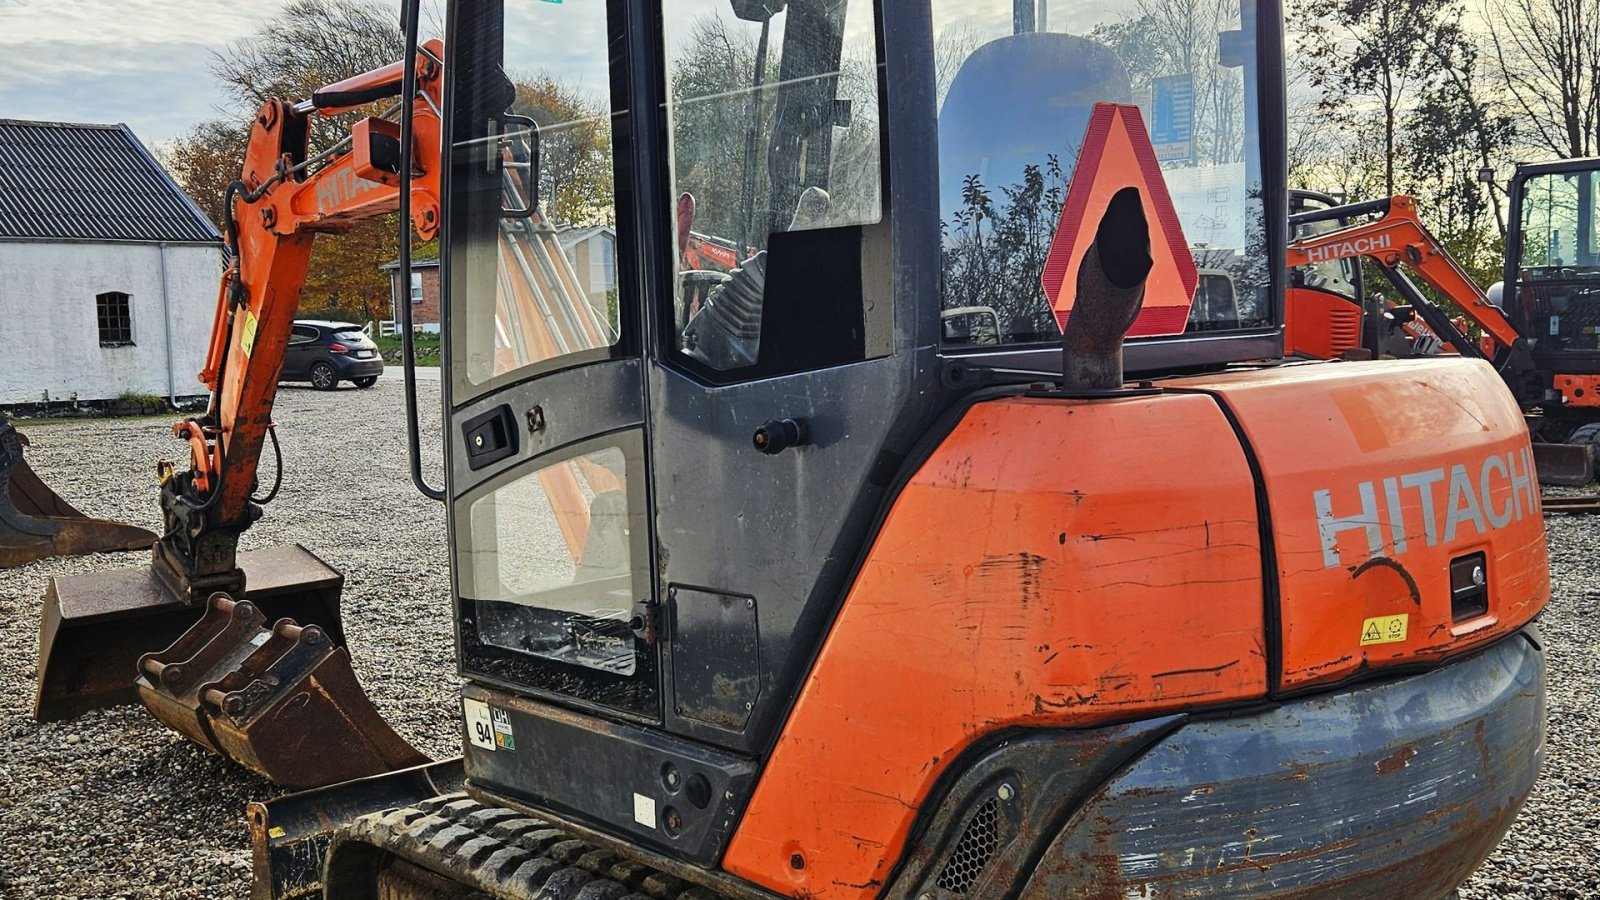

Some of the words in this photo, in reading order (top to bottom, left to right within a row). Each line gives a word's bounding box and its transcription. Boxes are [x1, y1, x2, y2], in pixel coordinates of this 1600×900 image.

[1307, 234, 1391, 262] HITACHI
[1313, 447, 1539, 569] HITACHI
[476, 721, 492, 745] 94
